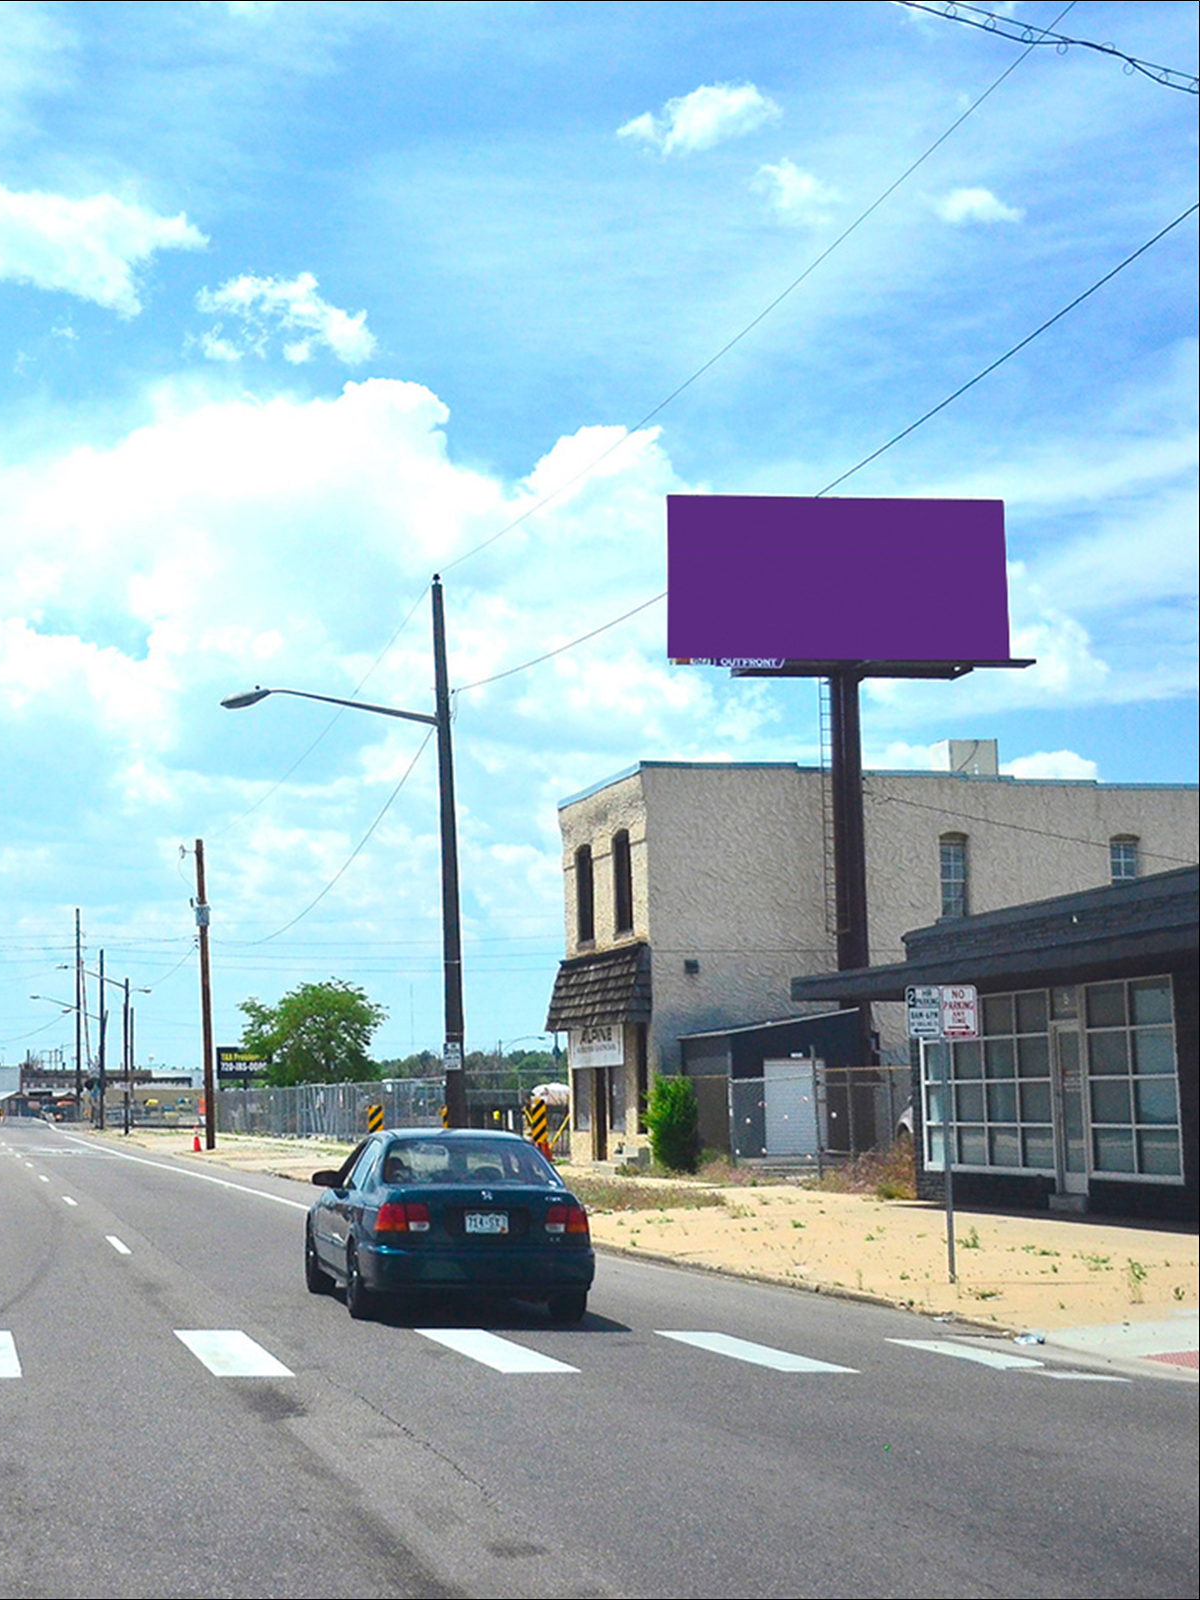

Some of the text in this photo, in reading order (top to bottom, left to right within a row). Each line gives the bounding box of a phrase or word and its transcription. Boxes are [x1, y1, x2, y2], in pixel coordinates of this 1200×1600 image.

[719, 658, 780, 668] OUTFRONT
[951, 989, 965, 999] NO
[942, 1001, 975, 1011] PARKING
